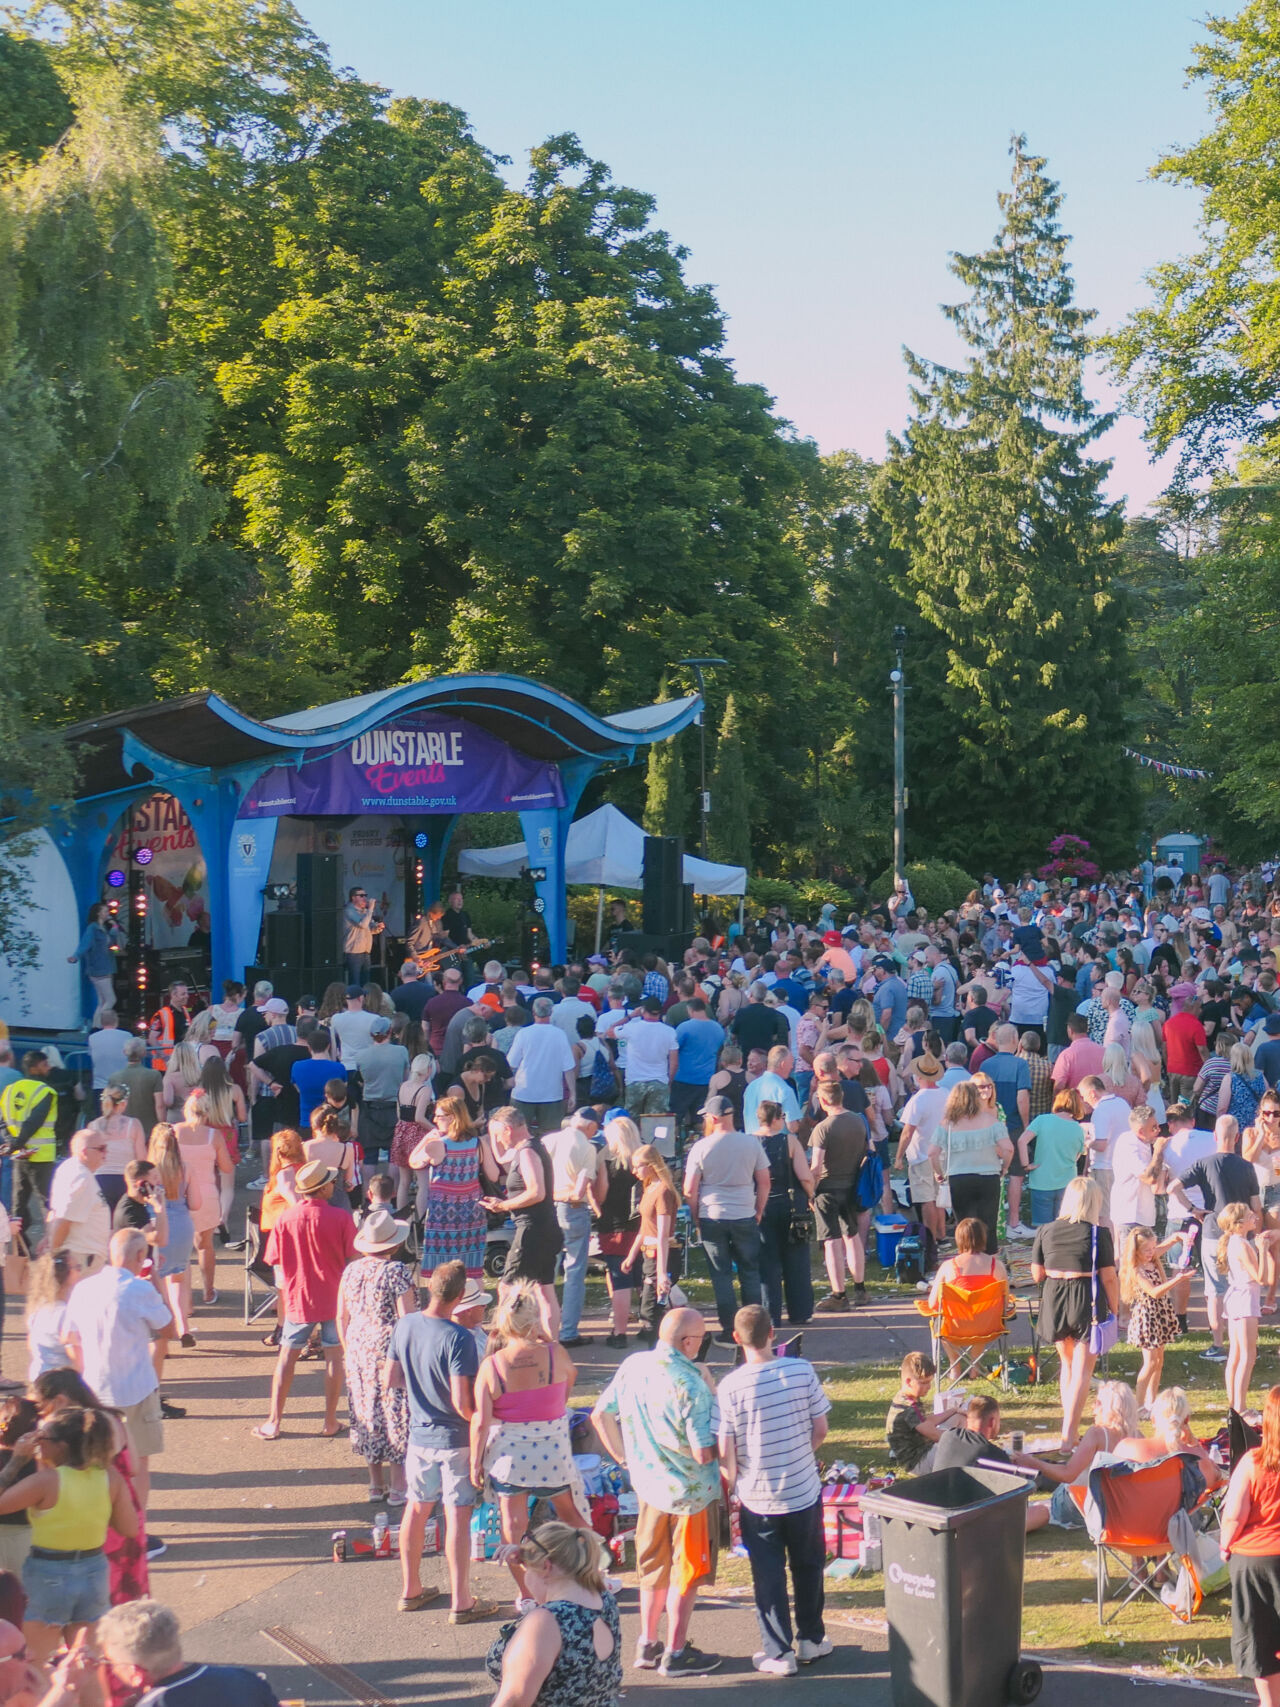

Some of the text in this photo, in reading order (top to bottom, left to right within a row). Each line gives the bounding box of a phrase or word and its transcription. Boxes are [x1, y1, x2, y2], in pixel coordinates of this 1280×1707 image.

[352, 731, 464, 766] DUNSTABLE
[366, 760, 446, 793] Events
[362, 796, 457, 807] www.dunstable.gov.uk
